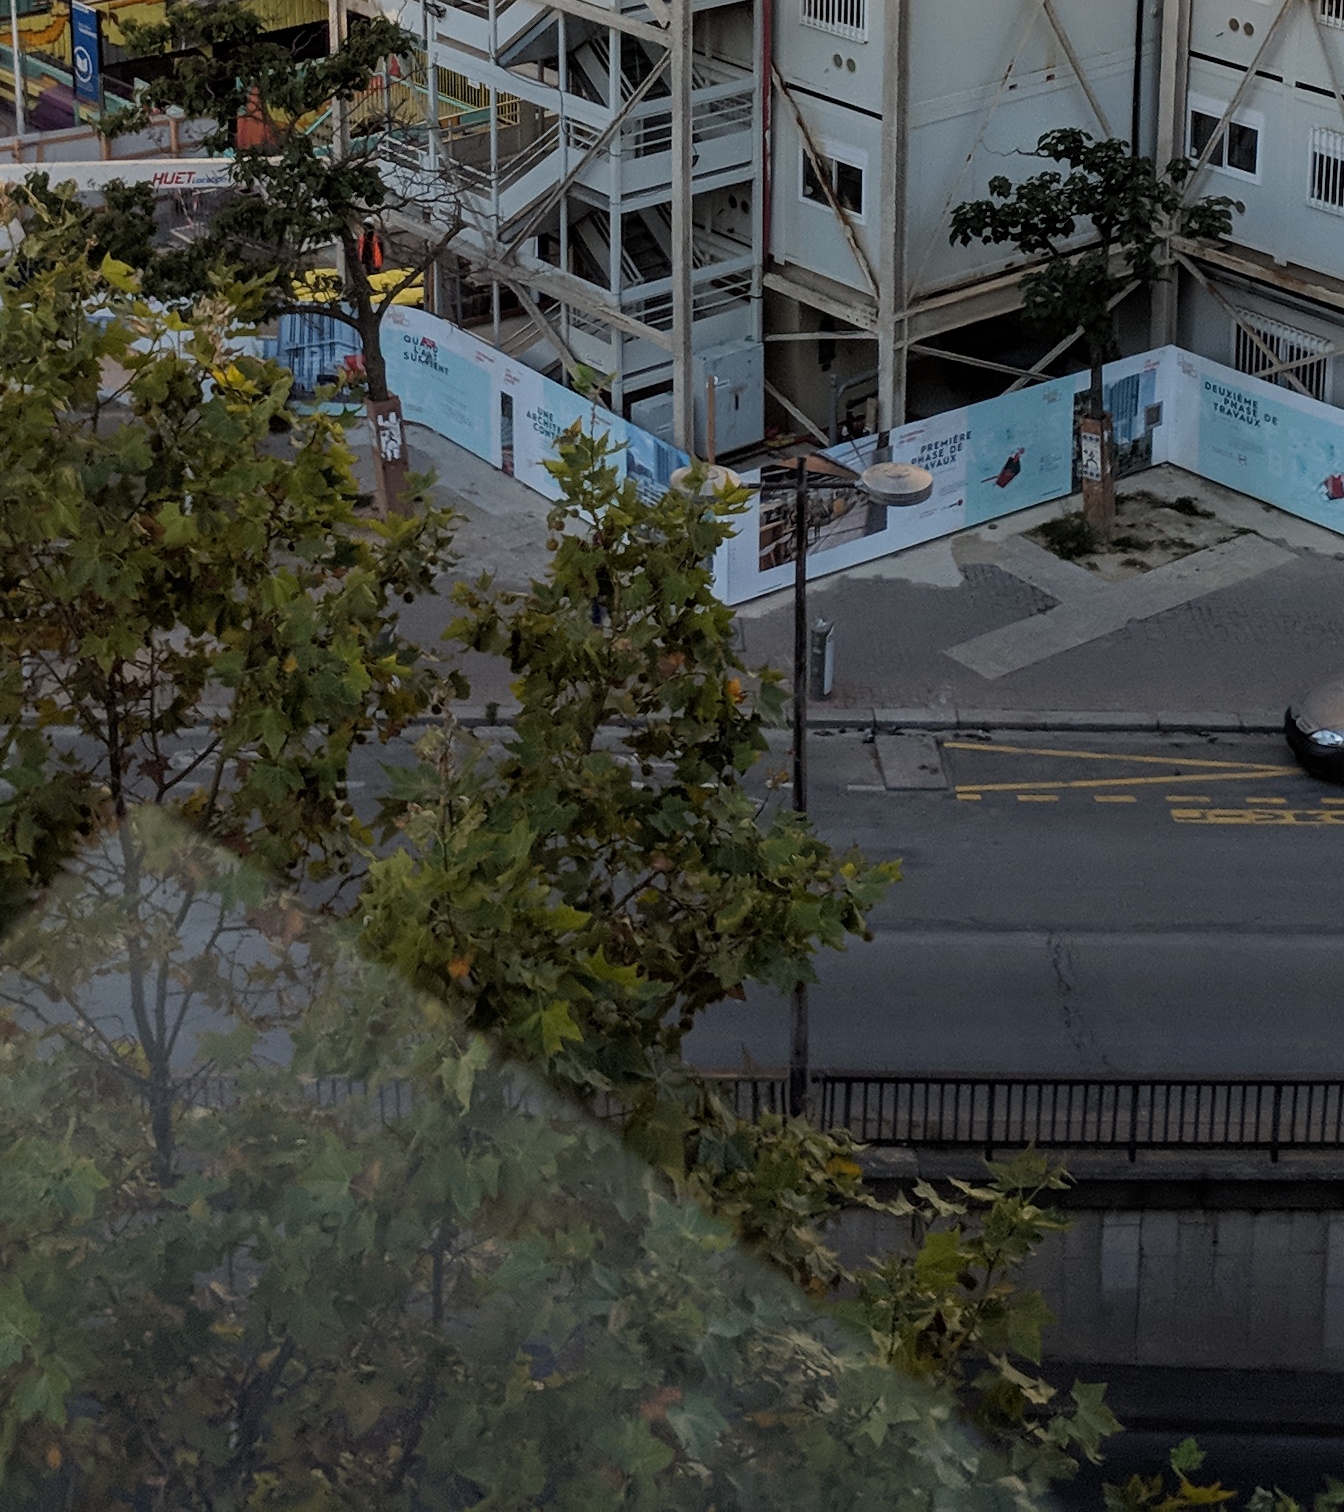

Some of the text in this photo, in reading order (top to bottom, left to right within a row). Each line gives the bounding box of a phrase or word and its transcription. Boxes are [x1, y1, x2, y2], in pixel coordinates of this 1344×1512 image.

[152, 171, 196, 185] HUET
[1204, 380, 1258, 408] DEUXIÈME
[537, 407, 554, 421] UNE
[1213, 402, 1261, 427] TRAVAUX
[1223, 396, 1279, 426] PHASE DE
[911, 443, 962, 465] PHASE DE
[920, 430, 972, 454] PREMIÈRE
